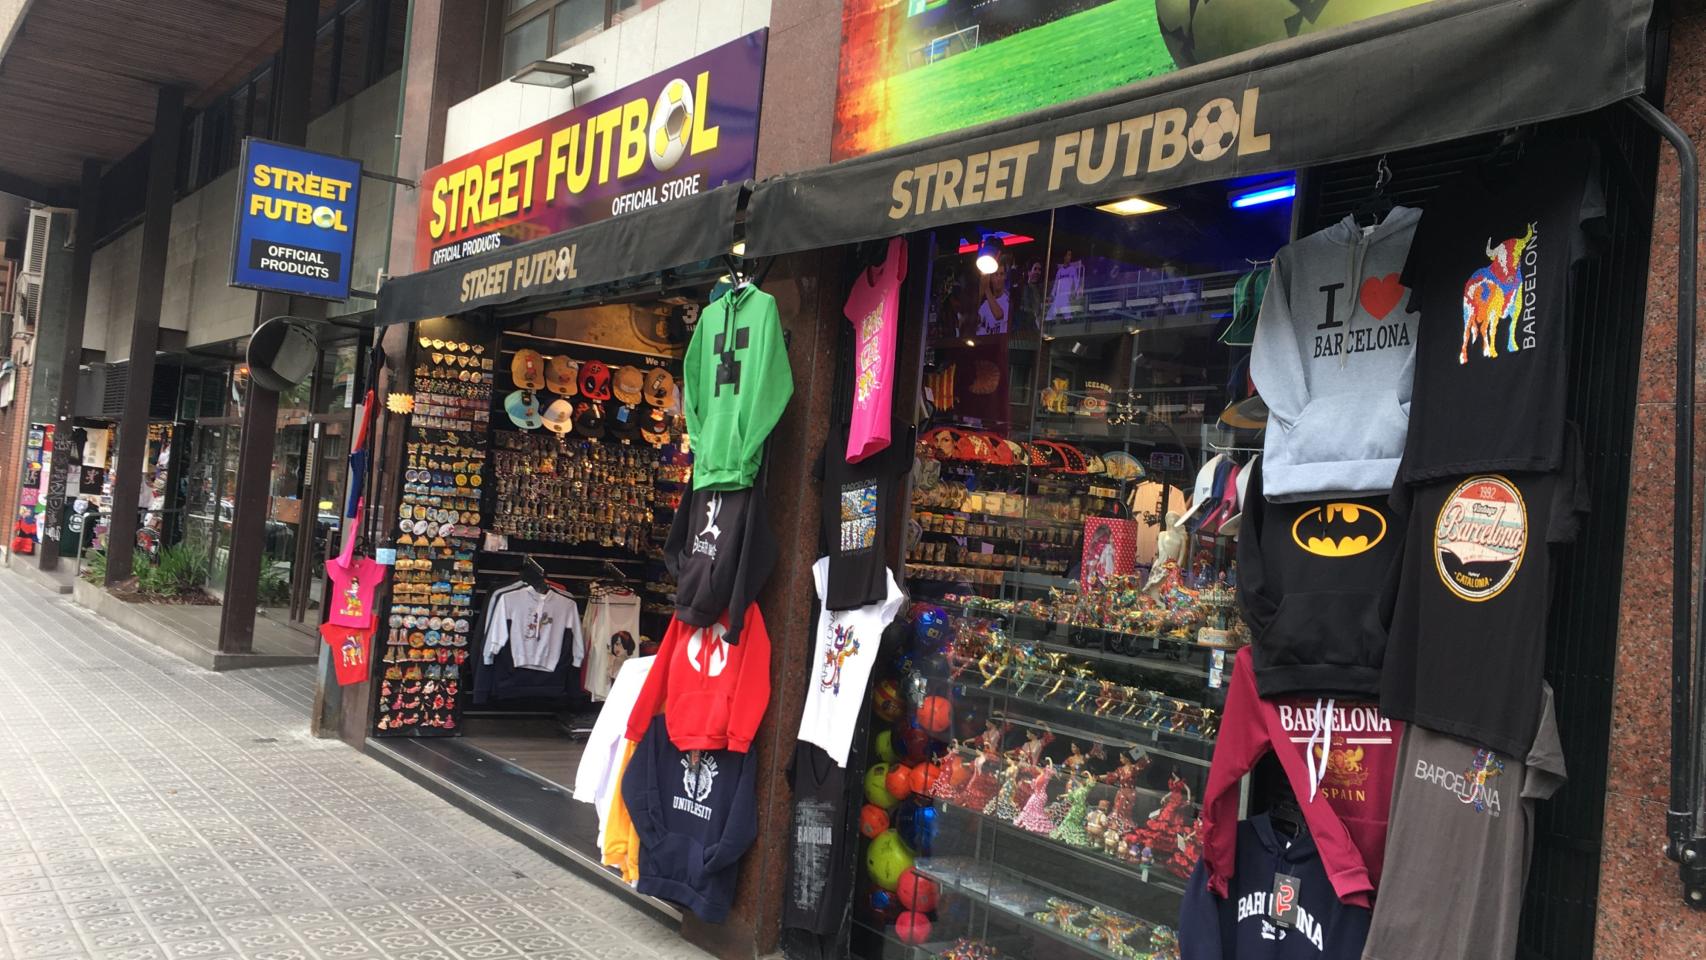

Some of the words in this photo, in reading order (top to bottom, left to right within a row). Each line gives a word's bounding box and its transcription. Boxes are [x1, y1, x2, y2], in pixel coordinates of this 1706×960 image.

[253, 164, 352, 202] STREET
[430, 138, 543, 239] STREET
[612, 186, 658, 216] OFFICIAL
[660, 173, 701, 203] STORE
[888, 140, 1040, 220] STREET
[260, 257, 330, 279] PRODUCTS
[268, 245, 325, 265] OFFICIAL
[432, 246, 461, 266] OFFICIAL
[461, 232, 501, 257] PRODUCTS
[460, 260, 513, 303] STREET
[1522, 220, 1539, 350] BARCELONA
[1317, 282, 1345, 330] I
[1313, 321, 1411, 359] BARCELONA
[1438, 501, 1524, 551] Barcelona
[1279, 704, 1392, 732] BARCELONA
[1321, 787, 1365, 802] SPAIN
[1414, 759, 1501, 812] BARCELONA
